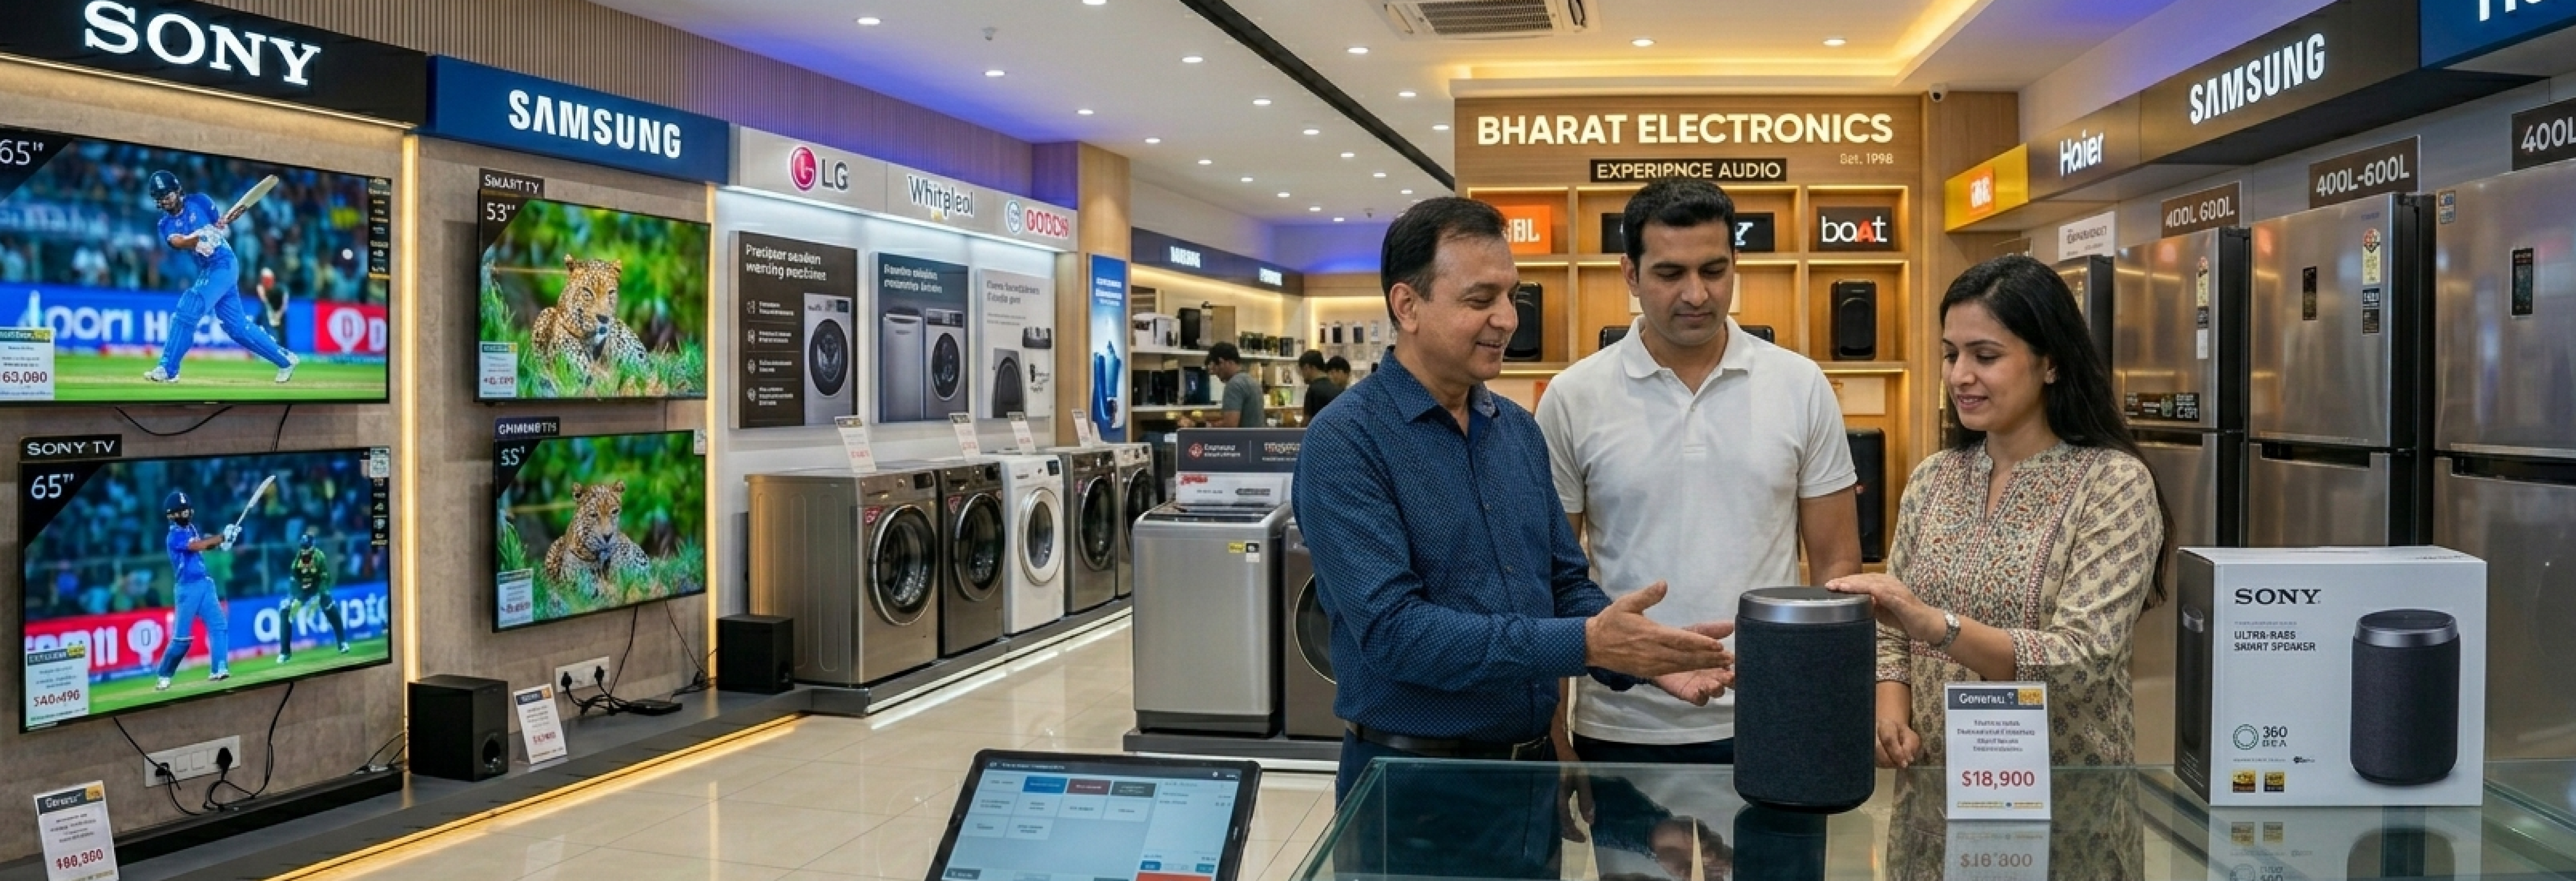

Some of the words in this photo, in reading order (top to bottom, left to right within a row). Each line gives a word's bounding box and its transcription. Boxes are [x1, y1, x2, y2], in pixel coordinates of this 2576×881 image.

[84, 0, 321, 86] SONY
[2189, 33, 2326, 126] SAMSUNG
[509, 89, 681, 159] SAMSUNG
[1478, 115, 1627, 145] BHARAT
[1638, 113, 1893, 144] ELECTRONICS
[2521, 116, 2576, 153] 400L
[2060, 129, 2104, 176] Haier
[821, 158, 848, 191] LG
[1718, 162, 1782, 178] AUDIO
[1821, 215, 1887, 243] boAt
[27, 442, 87, 456] SONY
[92, 440, 115, 454] TV
[2234, 588, 2322, 605] SONY
[2263, 725, 2288, 738] 360
[1962, 770, 2035, 790] $18,900
